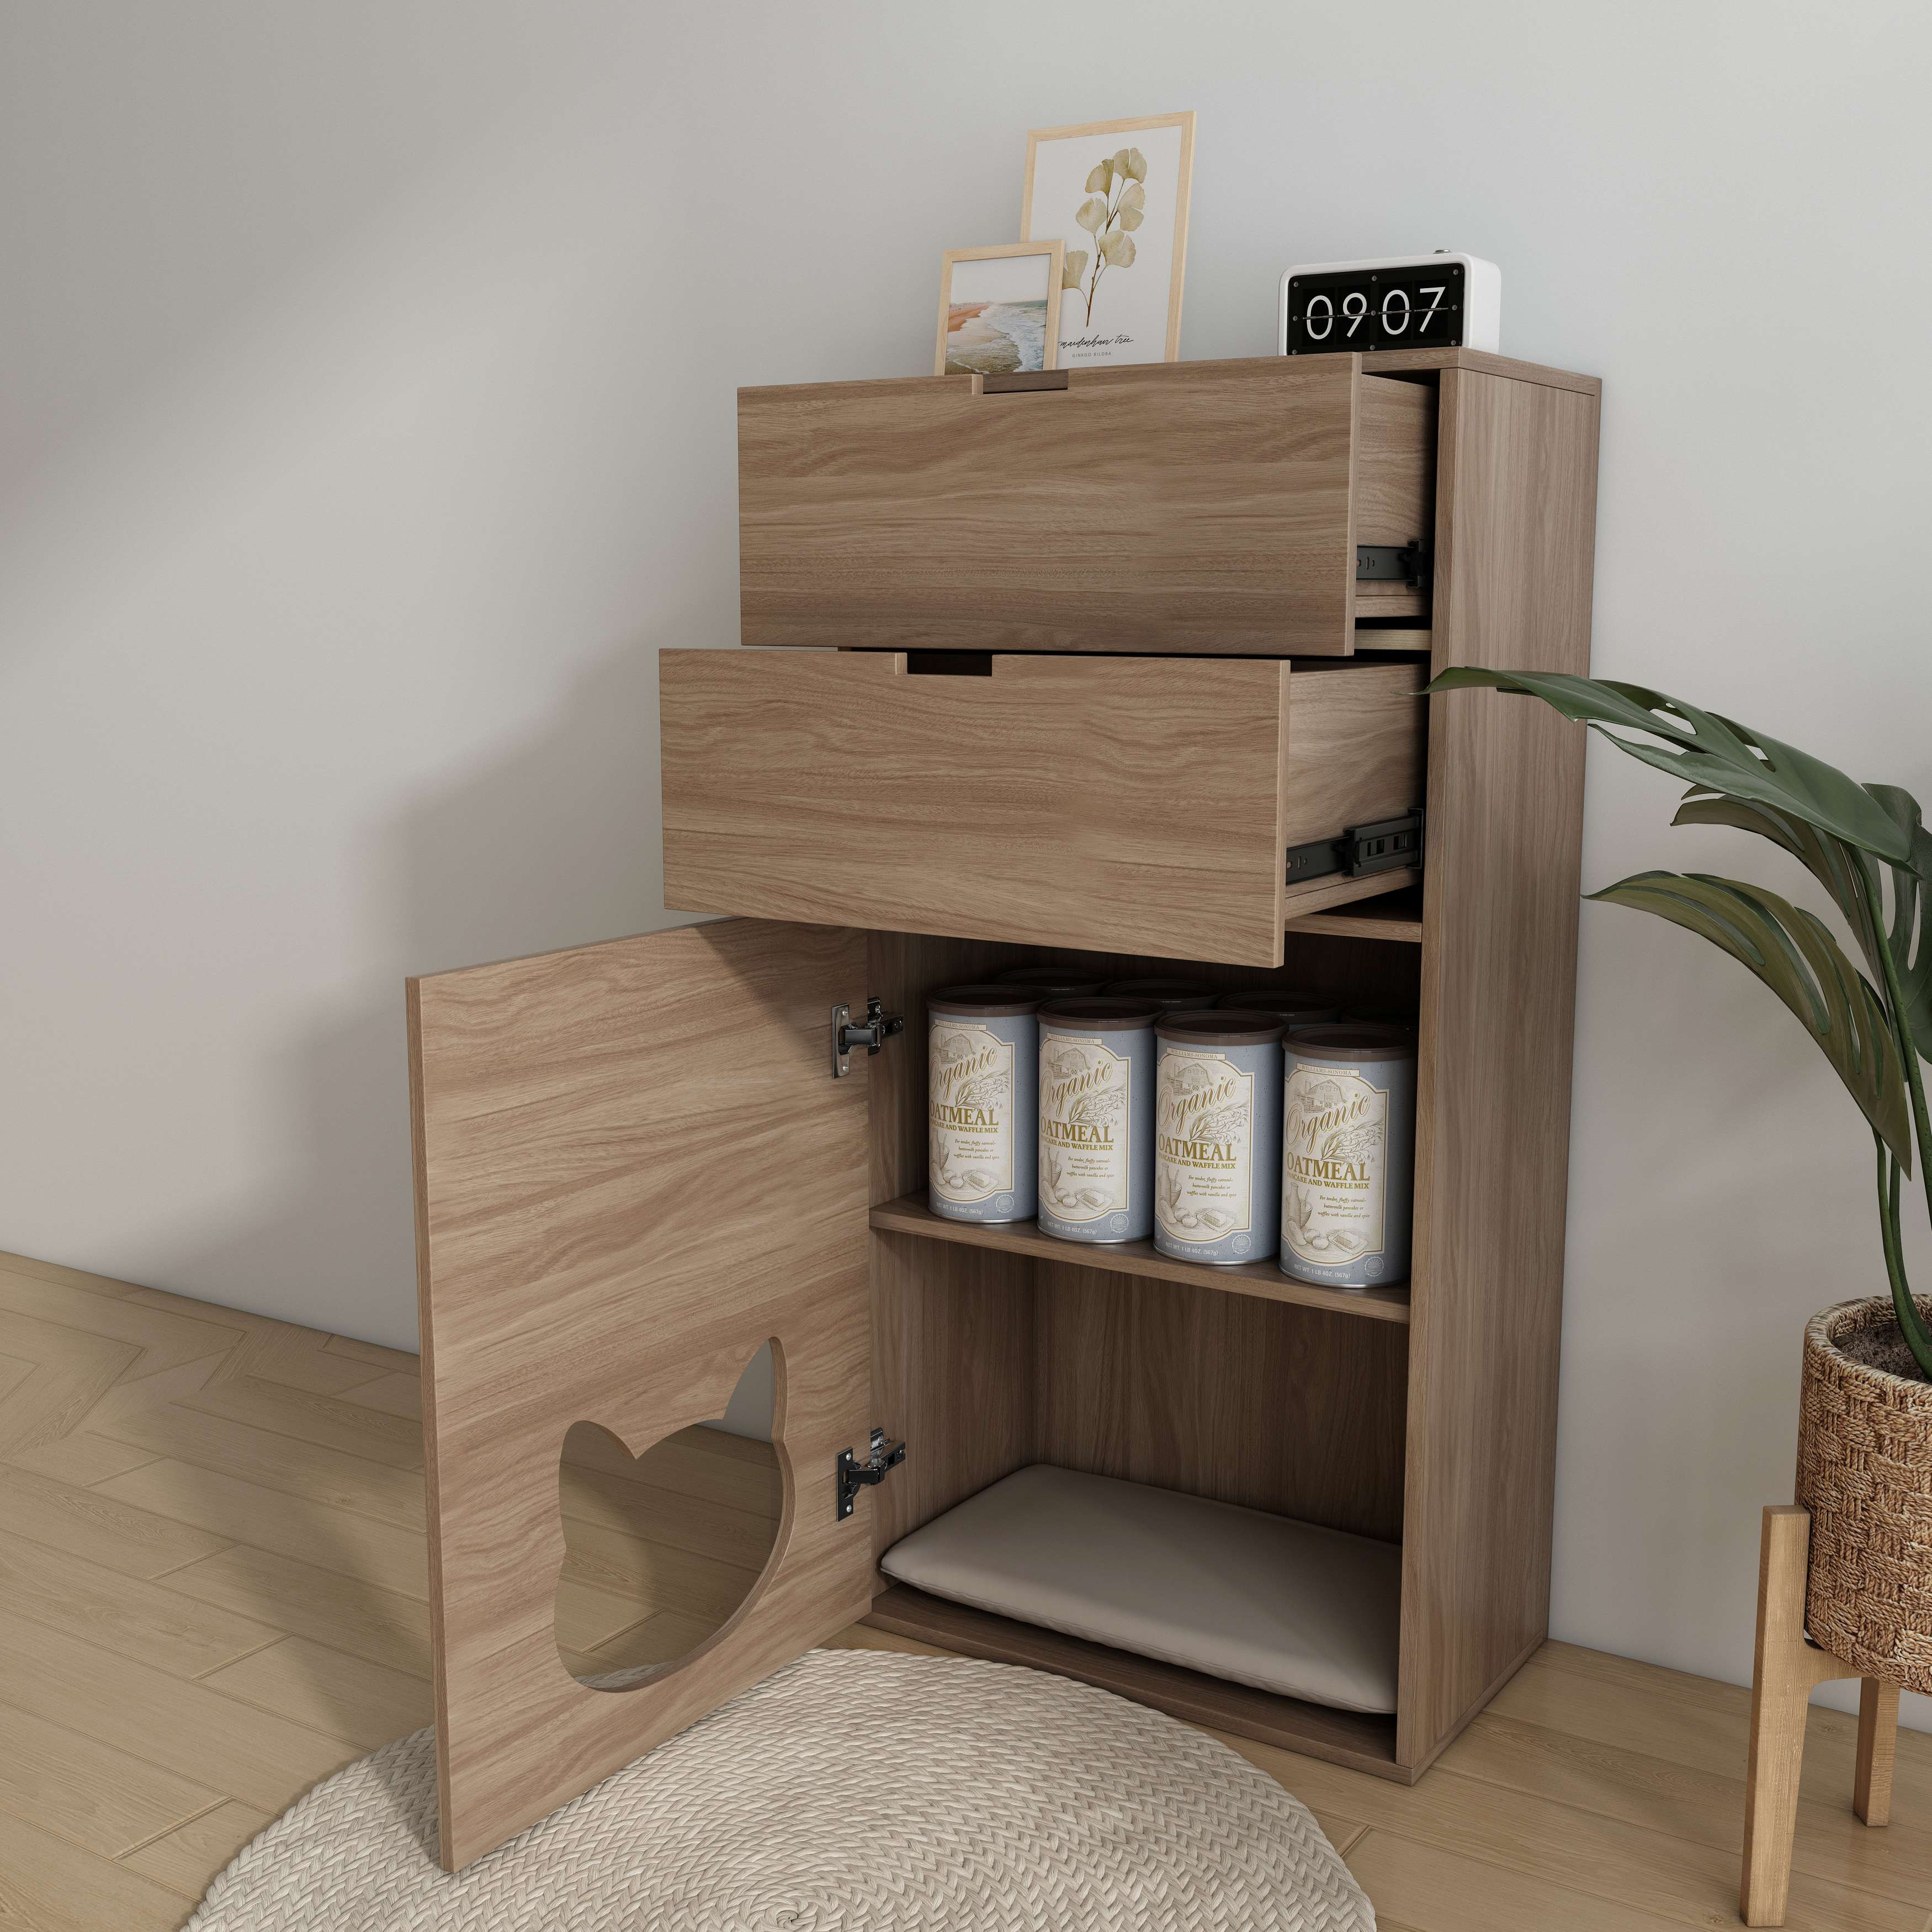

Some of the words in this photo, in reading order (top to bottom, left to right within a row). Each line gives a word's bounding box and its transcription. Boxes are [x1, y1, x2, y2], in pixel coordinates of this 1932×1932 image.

[938, 1020, 979, 1029] WILLIAMS-SONOMA
[1050, 1035, 1095, 1044] WILLIAMS-SONOMA
[1171, 1049, 1218, 1059] WILLIAMS-SONOMA
[1302, 1065, 1351, 1075] WILLIAMS-SONOMA
[1041, 1060, 1113, 1118] Organic
[930, 1100, 999, 1126] OATMEAL
[1158, 1076, 1236, 1135] Organic
[1041, 1116, 1114, 1143] OATMEAL
[1286, 1093, 1370, 1155] Organic
[1159, 1133, 1236, 1161] OATMEAL
[1159, 1152, 1177, 1164] PANCAKE
[1287, 1151, 1370, 1181] OATMEAL
[1287, 1171, 1308, 1184] PANCAKE
[1324, 1181, 1353, 1189] WAFFLE
